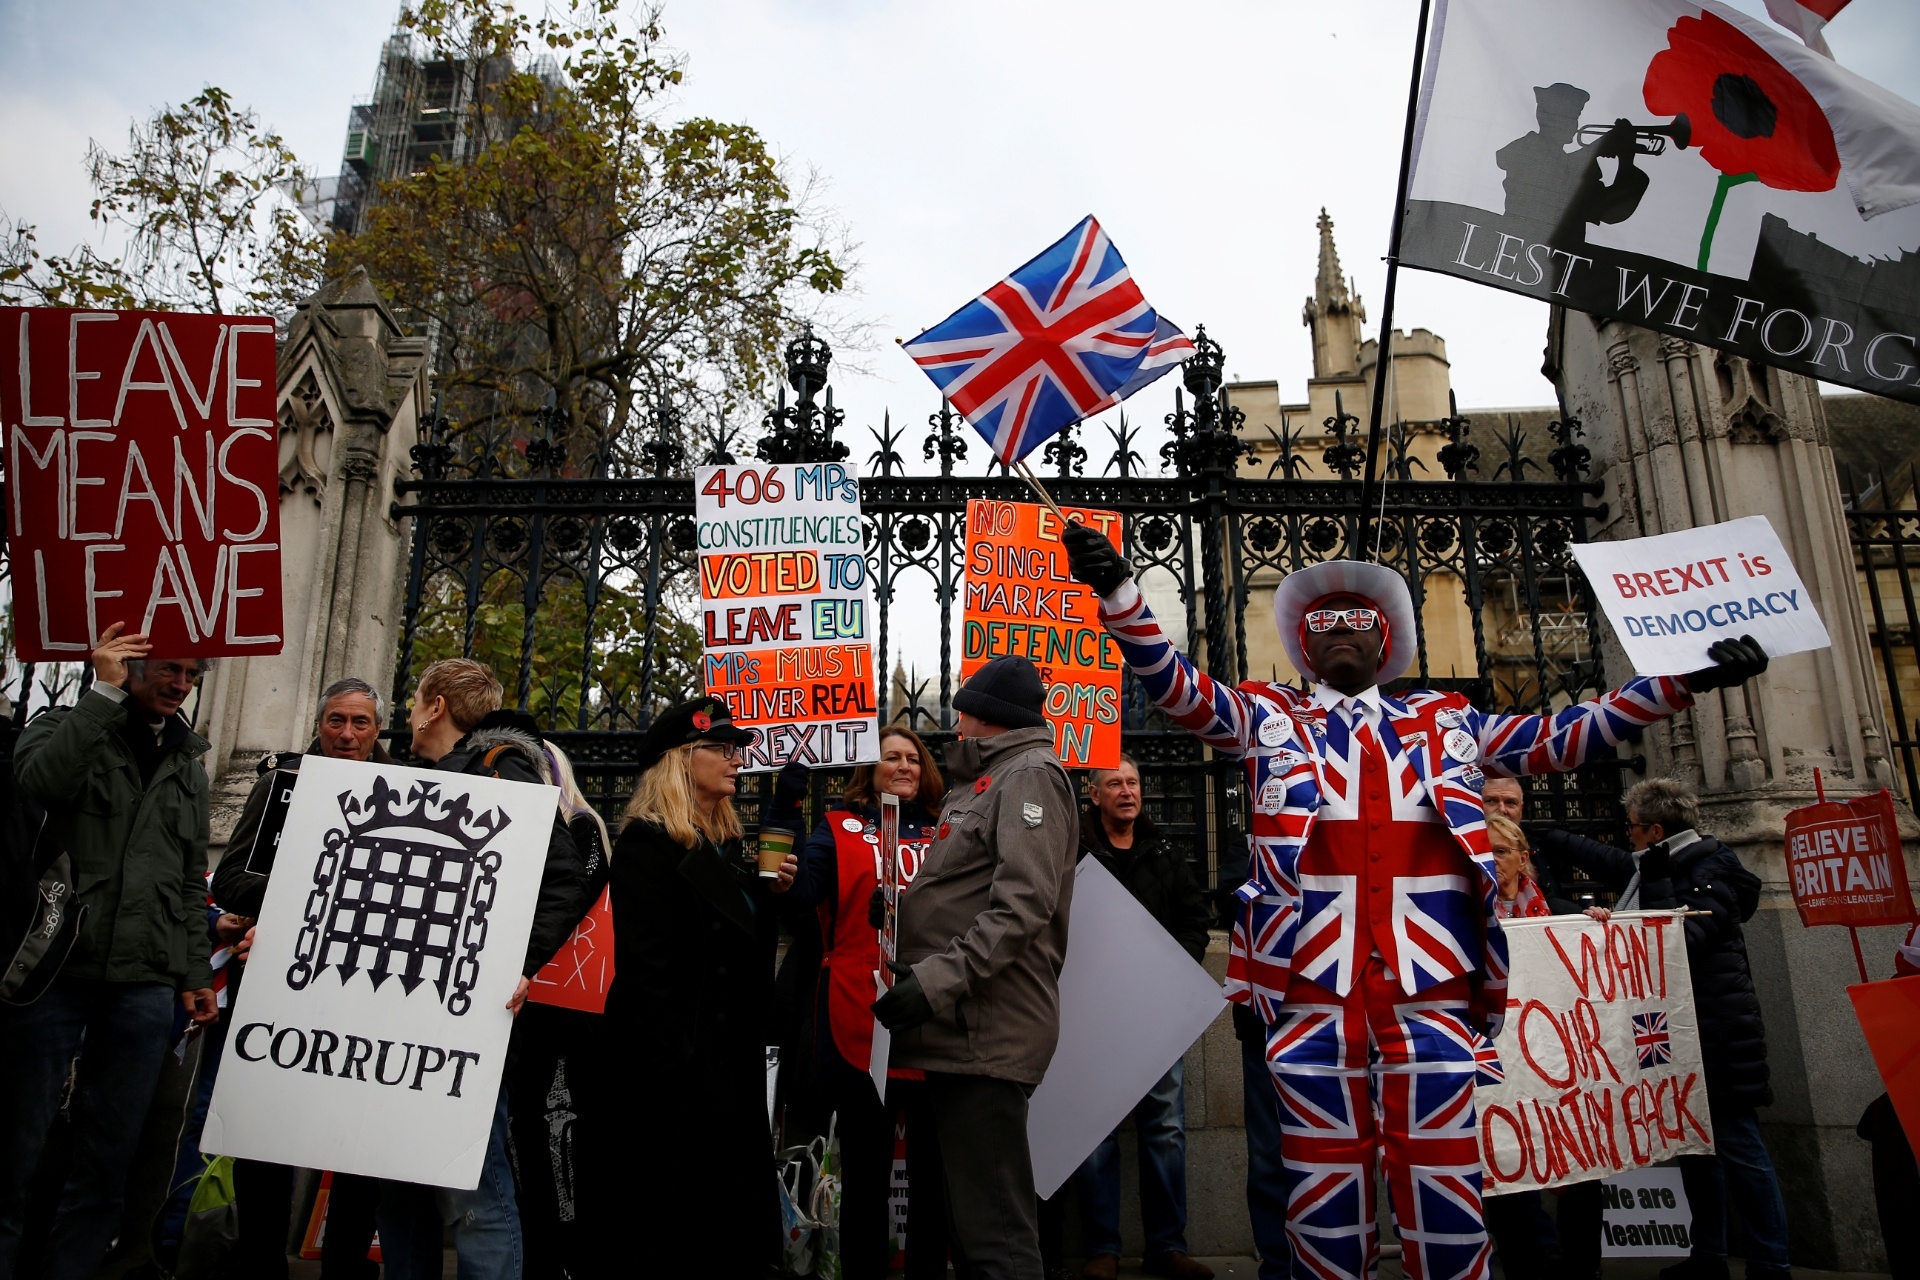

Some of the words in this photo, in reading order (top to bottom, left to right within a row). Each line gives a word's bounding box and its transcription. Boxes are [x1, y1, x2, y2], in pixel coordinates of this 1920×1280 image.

[1451, 221, 1592, 297] LEST
[1615, 266, 1710, 332] WE
[1719, 297, 1920, 388] FORG
[19, 311, 274, 429] LEAVE
[11, 424, 273, 541] MEANS
[701, 466, 785, 508] 406
[795, 463, 858, 503] MPs
[698, 516, 860, 549] CONSTITUENCIES
[973, 500, 1016, 537] NO
[34, 544, 281, 650] LEAVE
[701, 552, 819, 599] VOTED
[824, 553, 866, 590] TO
[1613, 557, 1730, 599] BREXIT
[1737, 552, 1772, 578] is
[704, 602, 802, 648] LEAVE
[811, 599, 864, 640] EU
[966, 582, 1100, 623] MARKE
[1623, 589, 1800, 637] DEMOCRACY
[706, 651, 760, 687] MPs
[776, 645, 868, 682] MUST
[964, 620, 1119, 671] DEFENCE
[812, 682, 876, 716] REAL
[740, 721, 868, 771] REXIT
[1791, 826, 1869, 861] BELIEVE
[1793, 853, 1892, 897] BRITAIN
[1544, 916, 1673, 1003] WANT
[234, 1021, 480, 1099] CORRUPT
[1518, 997, 1624, 1089] OUR
[1481, 1086, 1623, 1190] OUNTRY
[1621, 1073, 1711, 1165] BACK
[1601, 1184, 1635, 1210] We
[1636, 1187, 1677, 1210] are
[1602, 1219, 1691, 1249] leaving
